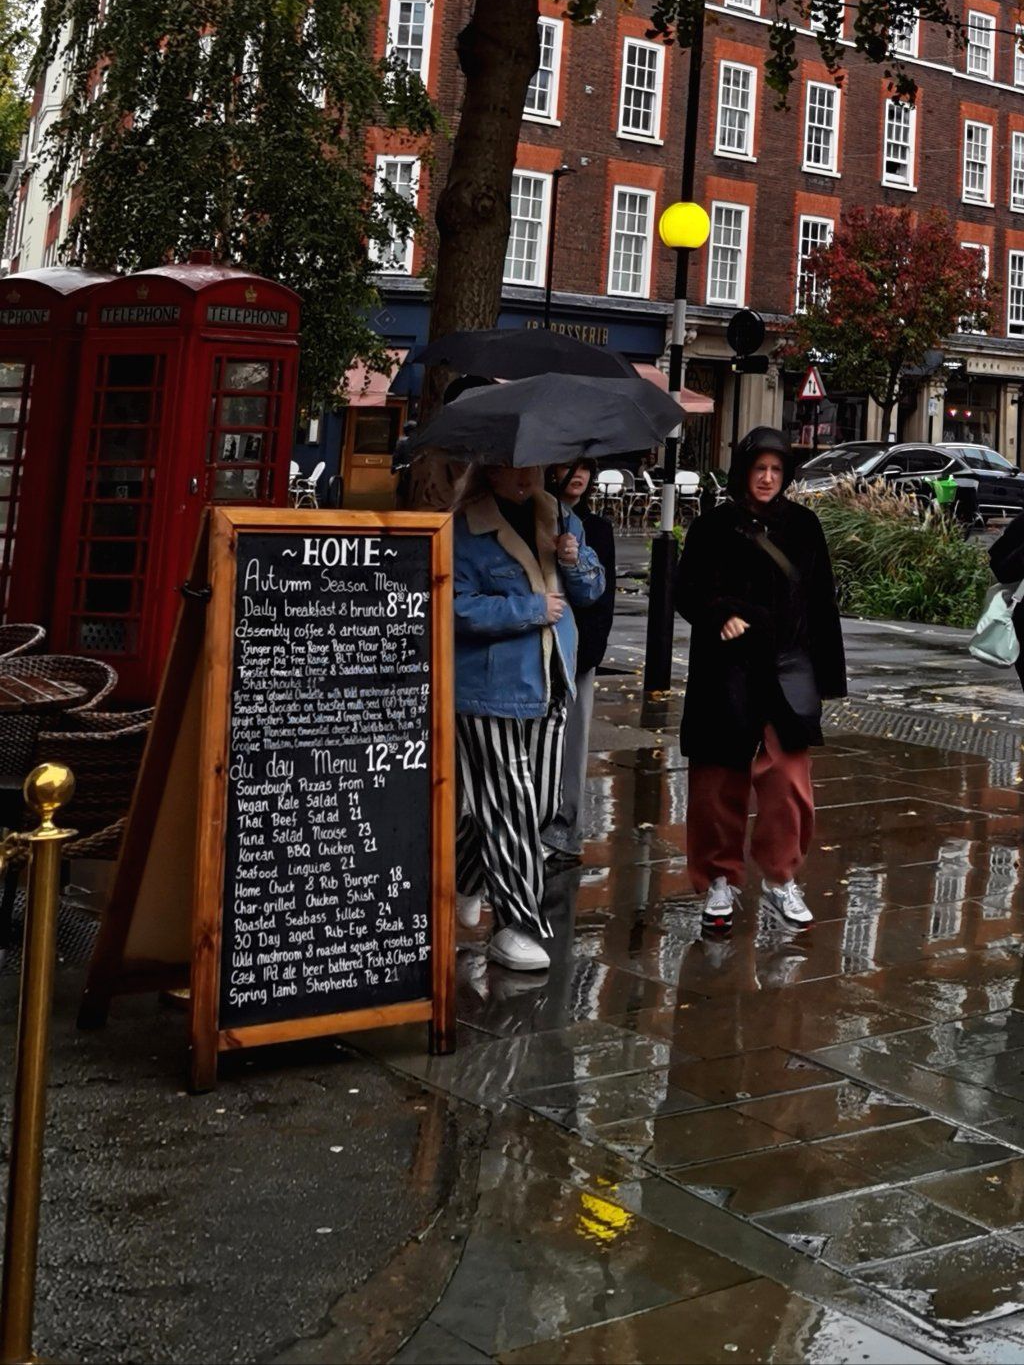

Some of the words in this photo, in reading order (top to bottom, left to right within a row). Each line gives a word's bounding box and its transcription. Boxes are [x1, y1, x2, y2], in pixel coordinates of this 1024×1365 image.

[103, 306, 180, 323] TELEPHONE
[210, 308, 287, 326] TELEPHONE
[302, 538, 381, 566] HOME
[244, 558, 311, 593] Autumn
[320, 568, 368, 592] Season
[374, 572, 408, 592] Menu
[242, 596, 277, 621] Daily
[285, 599, 335, 617] breakfast
[339, 602, 347, 615] &
[351, 600, 385, 617] brunch
[294, 623, 324, 639] coffee
[327, 623, 336, 636] &
[386, 621, 425, 637] pastries
[291, 641, 306, 654] Free
[307, 640, 330, 655] Range
[331, 638, 355, 652] Bacon
[401, 638, 407, 649] 7
[291, 654, 306, 665] Free
[307, 654, 330, 666] Range
[335, 652, 353, 664] BLT
[422, 662, 430, 672] 6
[421, 683, 430, 694] 12
[266, 751, 294, 780] day
[311, 748, 357, 775] Menu
[236, 779, 292, 797] Sourdough
[298, 777, 332, 792] Pizzas
[338, 775, 364, 791] from
[373, 774, 385, 788] 14
[237, 797, 269, 815] Vegan
[277, 795, 300, 810] Kale
[306, 793, 338, 808] Salad
[237, 814, 263, 829] Thai
[271, 811, 298, 827] Beef
[307, 809, 339, 824] Salad
[349, 806, 362, 820] 21
[238, 831, 265, 846] Tuna
[272, 827, 303, 843] Salad
[312, 826, 347, 840] Nicoise
[358, 822, 372, 836] 23
[239, 847, 275, 862] Korean
[286, 843, 311, 858] BBQ
[318, 841, 355, 855] Chicken
[363, 837, 378, 852] 21
[235, 865, 278, 879] Seafood
[288, 861, 331, 877] Linguine
[340, 855, 356, 870] 21
[234, 882, 261, 898] Home
[269, 879, 295, 894] Chuck
[304, 875, 314, 891] &
[319, 875, 338, 890] Rib
[343, 872, 380, 888] Burger
[389, 865, 403, 882] 18
[234, 896, 296, 916] Char-grilled
[305, 892, 339, 908] Chicken
[346, 888, 375, 904] Shish
[234, 914, 276, 933] Roasted
[285, 910, 327, 926] Seabass
[335, 906, 366, 922] fillets
[378, 901, 392, 916] 24
[234, 933, 252, 950] 30
[258, 932, 280, 948] Day
[288, 926, 315, 945] aged
[324, 922, 368, 939] Rib-Eye
[375, 916, 404, 933] Steak
[412, 914, 428, 929] 33
[232, 951, 253, 967] Wild
[257, 949, 303, 965] mushroom
[305, 943, 314, 958] &
[316, 941, 347, 957] roasted
[350, 939, 379, 956] squash
[383, 935, 414, 949] risotto
[414, 931, 426, 945] 18
[231, 969, 256, 985] Cask
[282, 963, 297, 980] ale
[302, 961, 324, 977] beer
[328, 955, 364, 974] battered
[229, 987, 267, 1007] Spring
[272, 981, 298, 998] Lamb
[364, 969, 380, 985] Pie
[384, 966, 400, 983] 21
